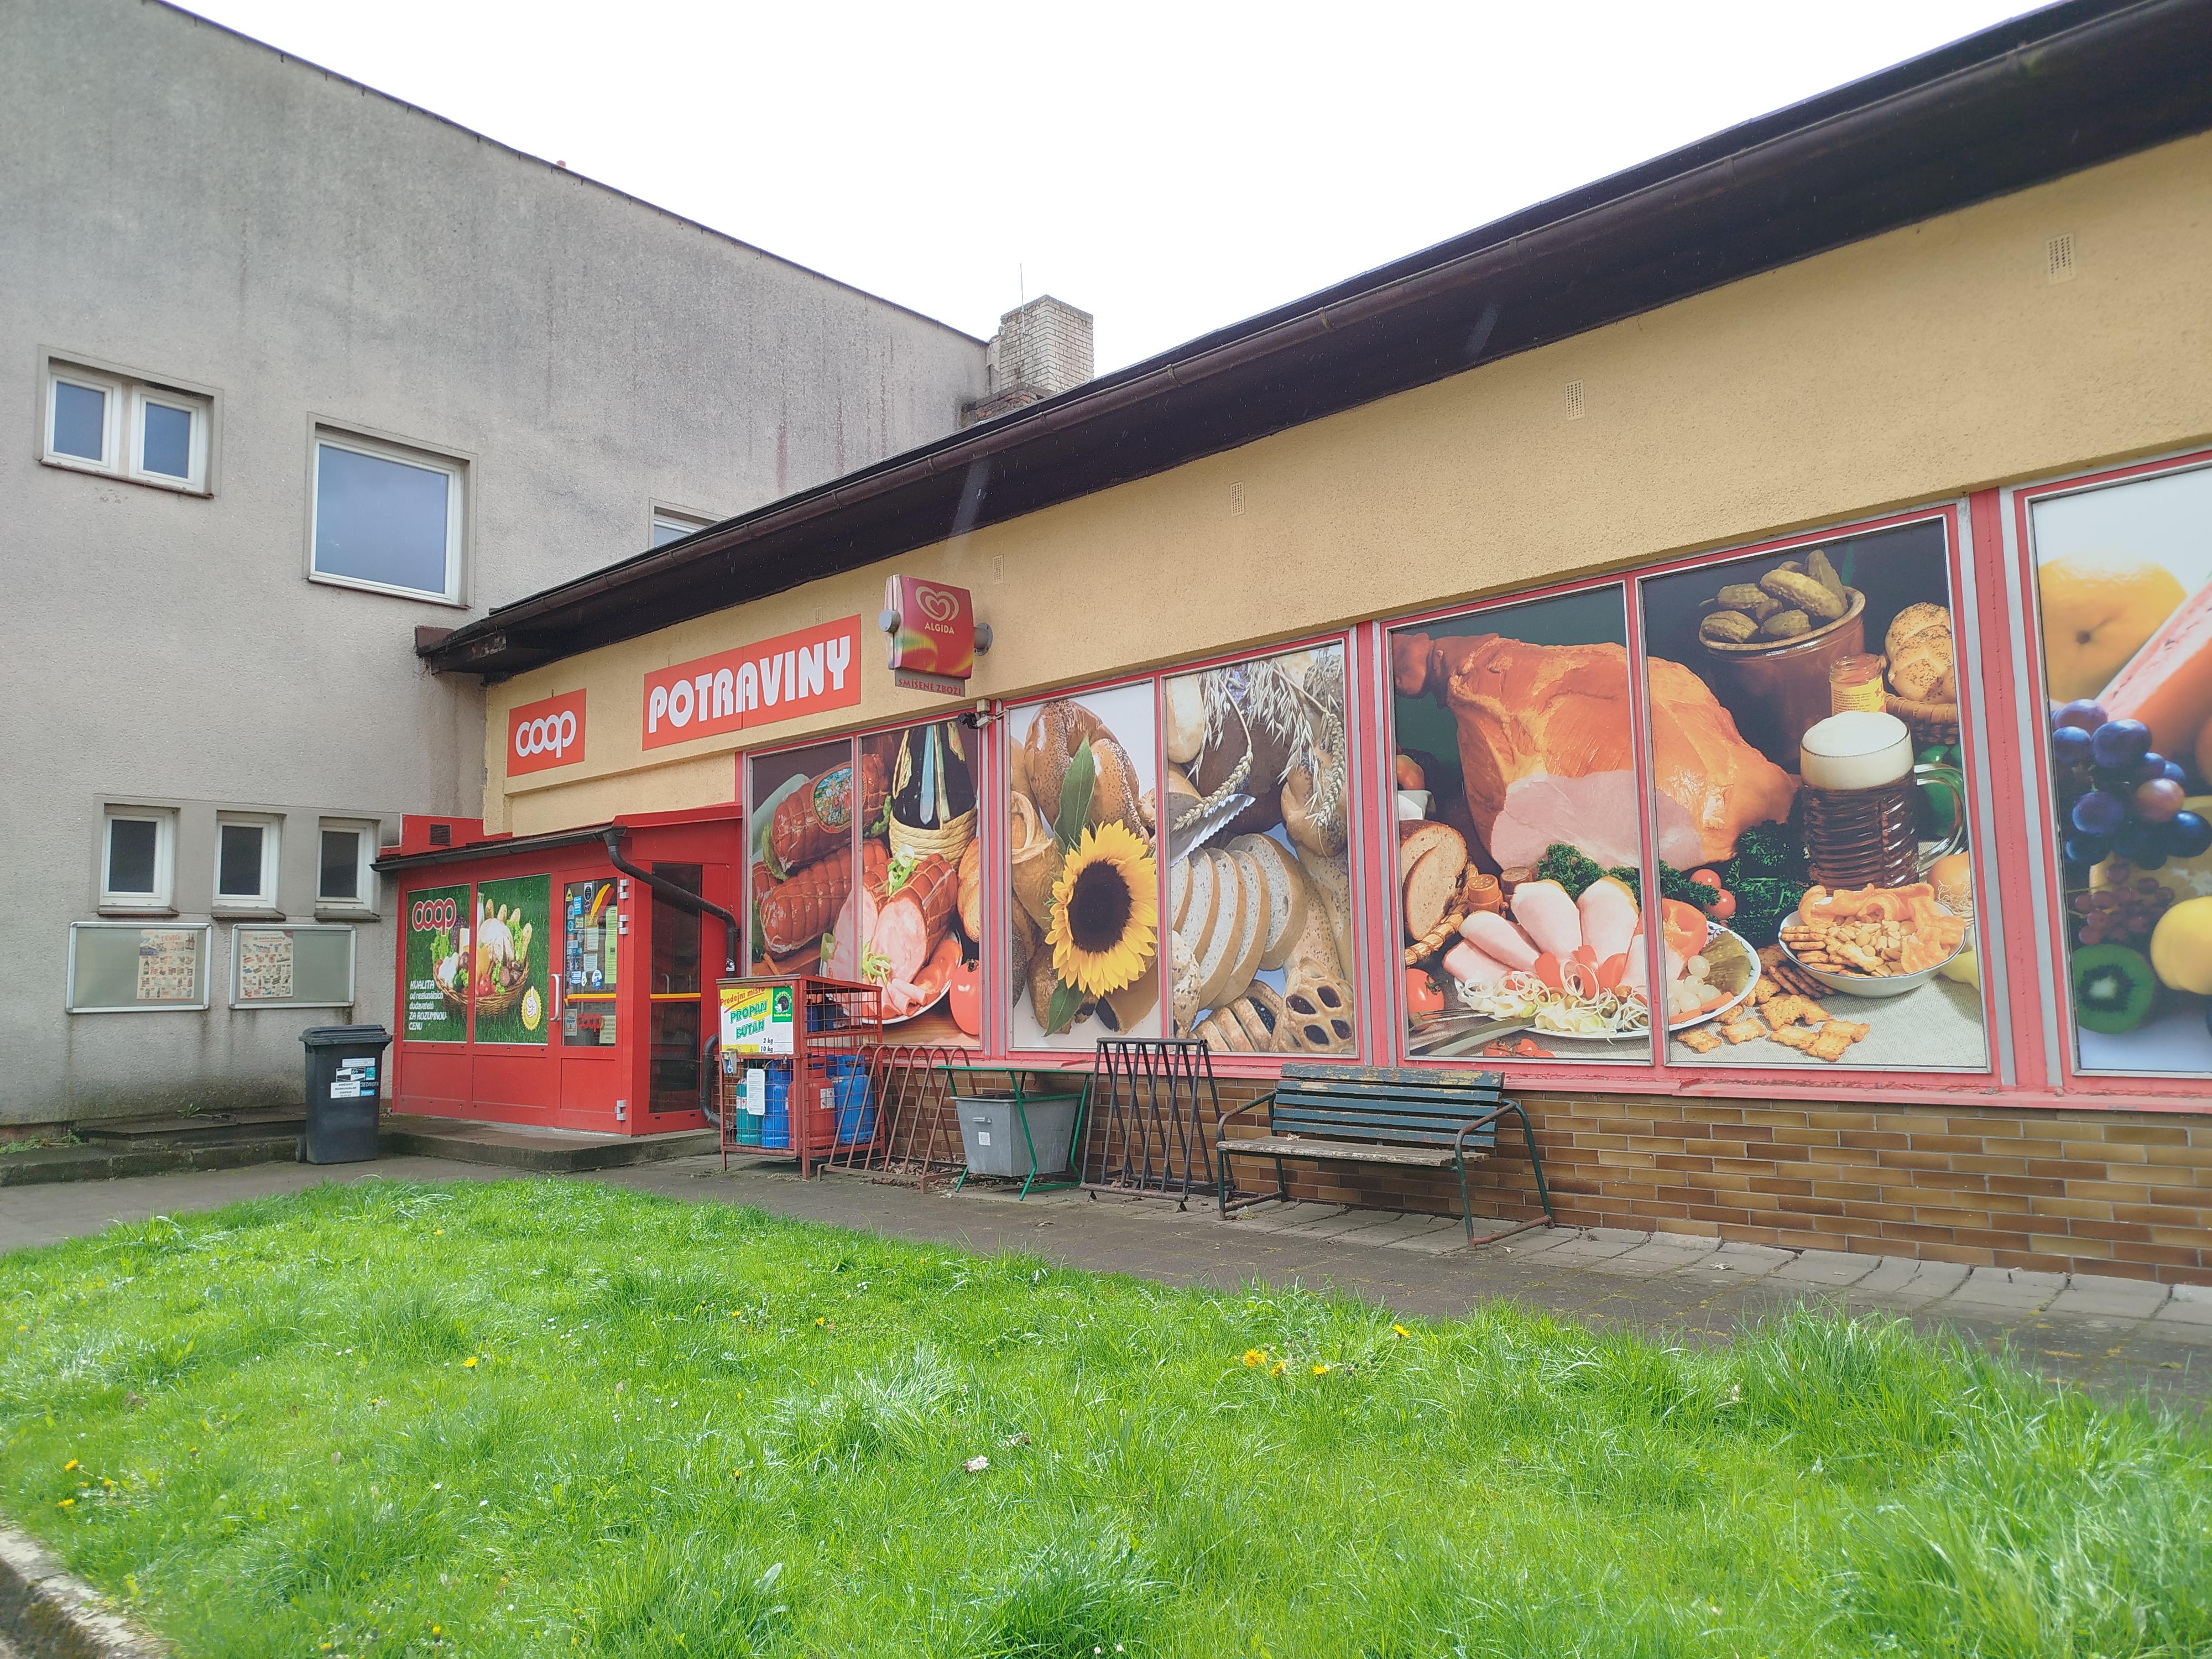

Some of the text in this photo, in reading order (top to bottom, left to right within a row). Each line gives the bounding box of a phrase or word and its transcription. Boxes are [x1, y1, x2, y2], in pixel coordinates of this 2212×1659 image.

[925, 622, 954, 634] ALGIDA
[648, 635, 851, 733] POTRAVINY
[515, 709, 577, 758] coop
[412, 897, 456, 936] coop
[410, 979, 435, 990] KVALITA
[409, 1011, 447, 1020] ZA ROZUMNOU
[730, 999, 768, 1024] PROPAN
[409, 1021, 423, 1030] CENU
[735, 1018, 765, 1040] BUTAN
